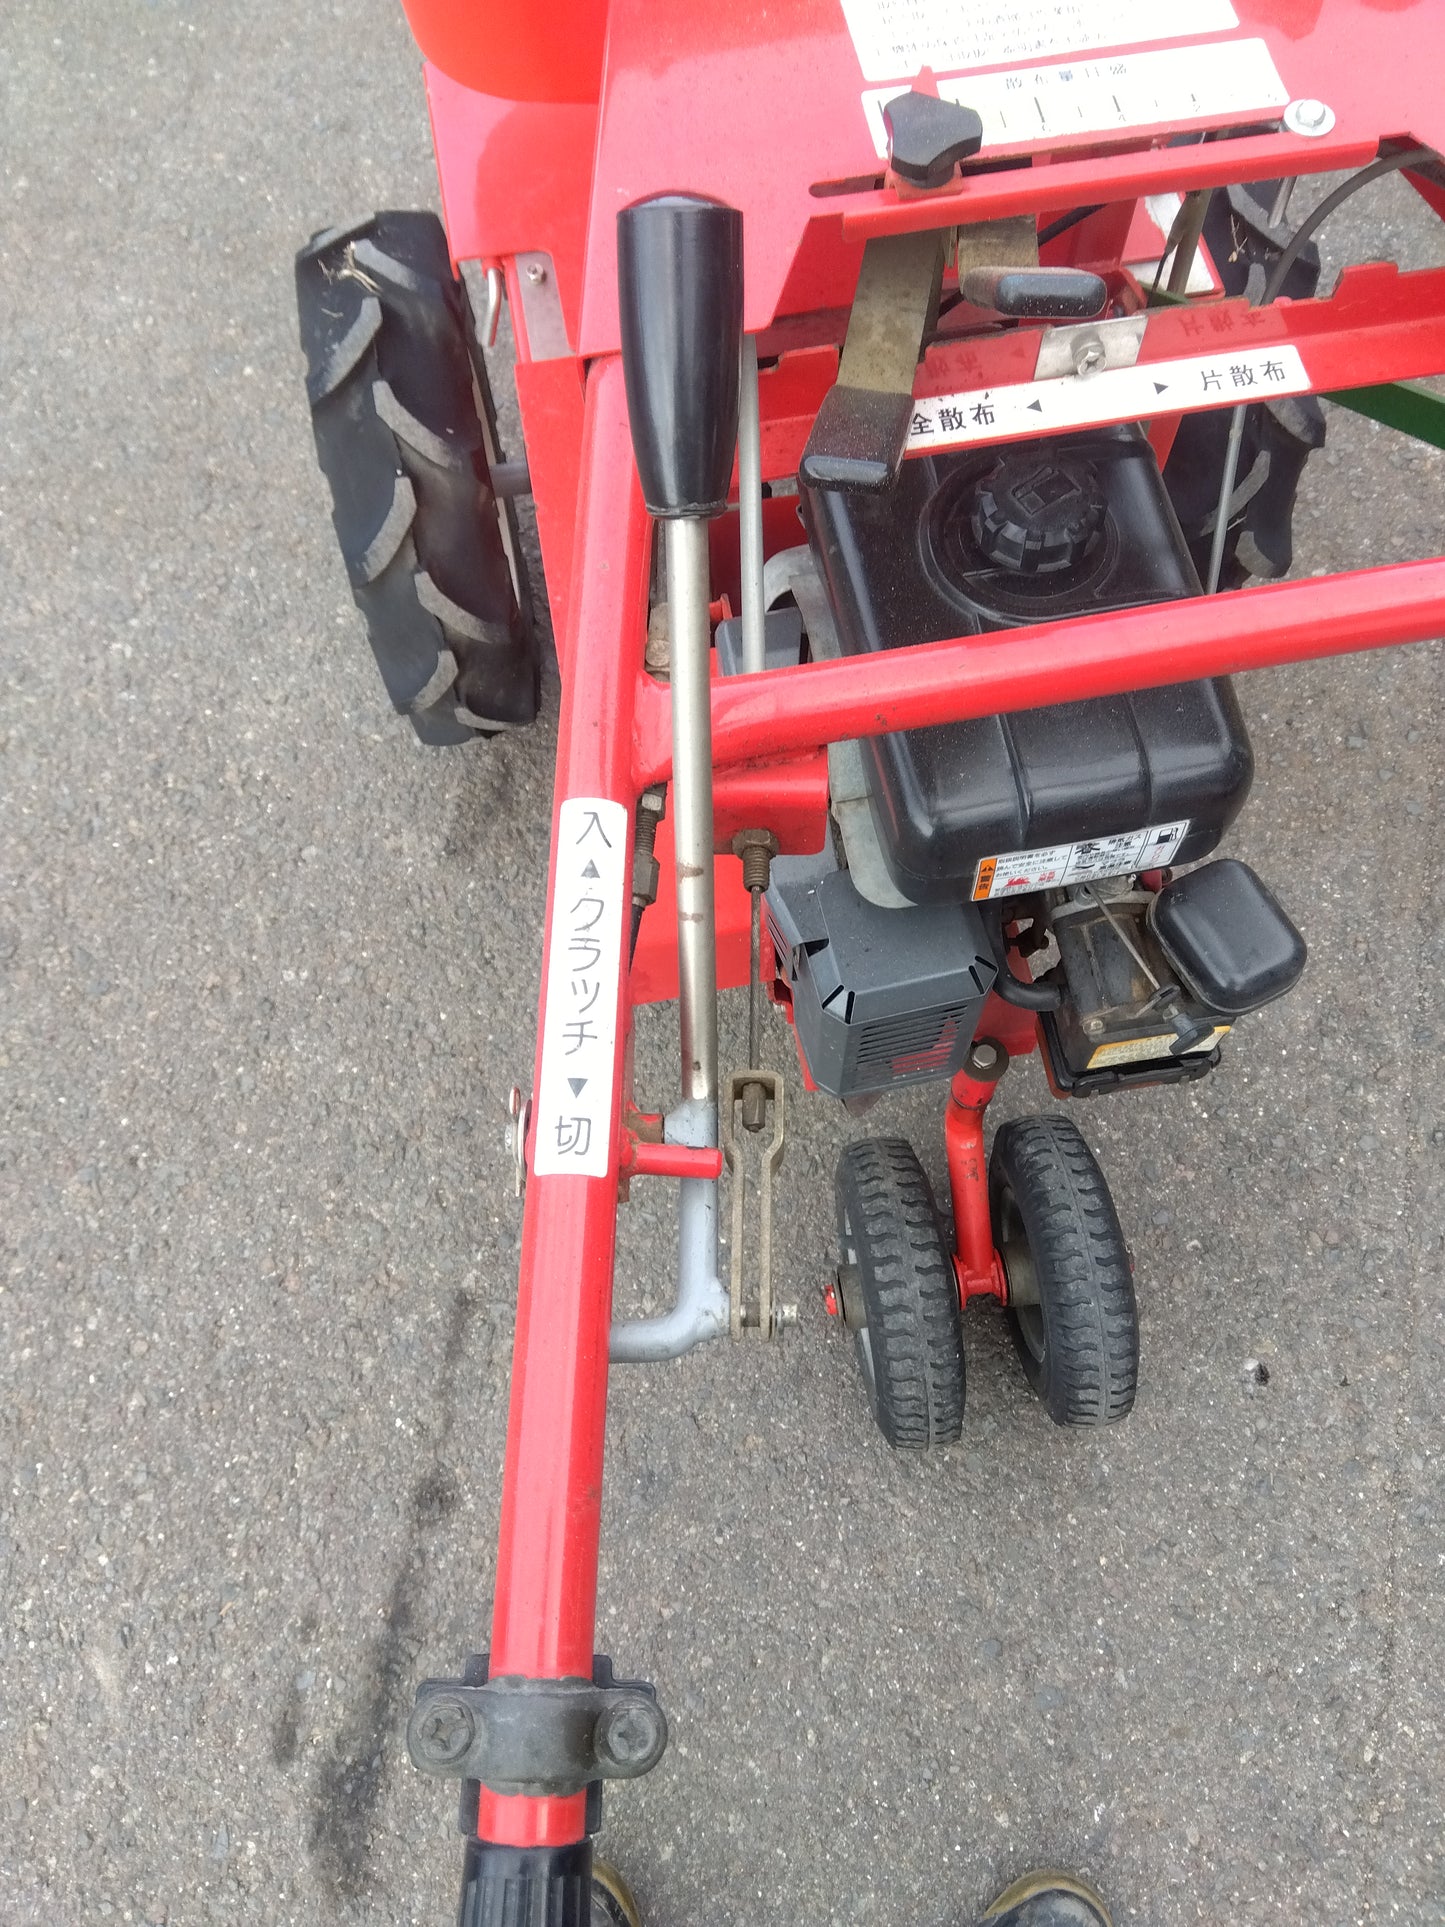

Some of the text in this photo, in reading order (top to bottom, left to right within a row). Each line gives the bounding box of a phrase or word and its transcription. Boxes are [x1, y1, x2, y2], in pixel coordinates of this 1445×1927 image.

[1200, 360, 1287, 392] 片散布
[910, 402, 996, 437] 全散布
[575, 811, 613, 849] 入
[562, 897, 605, 1056] クラッチ
[554, 1115, 592, 1156] 切
